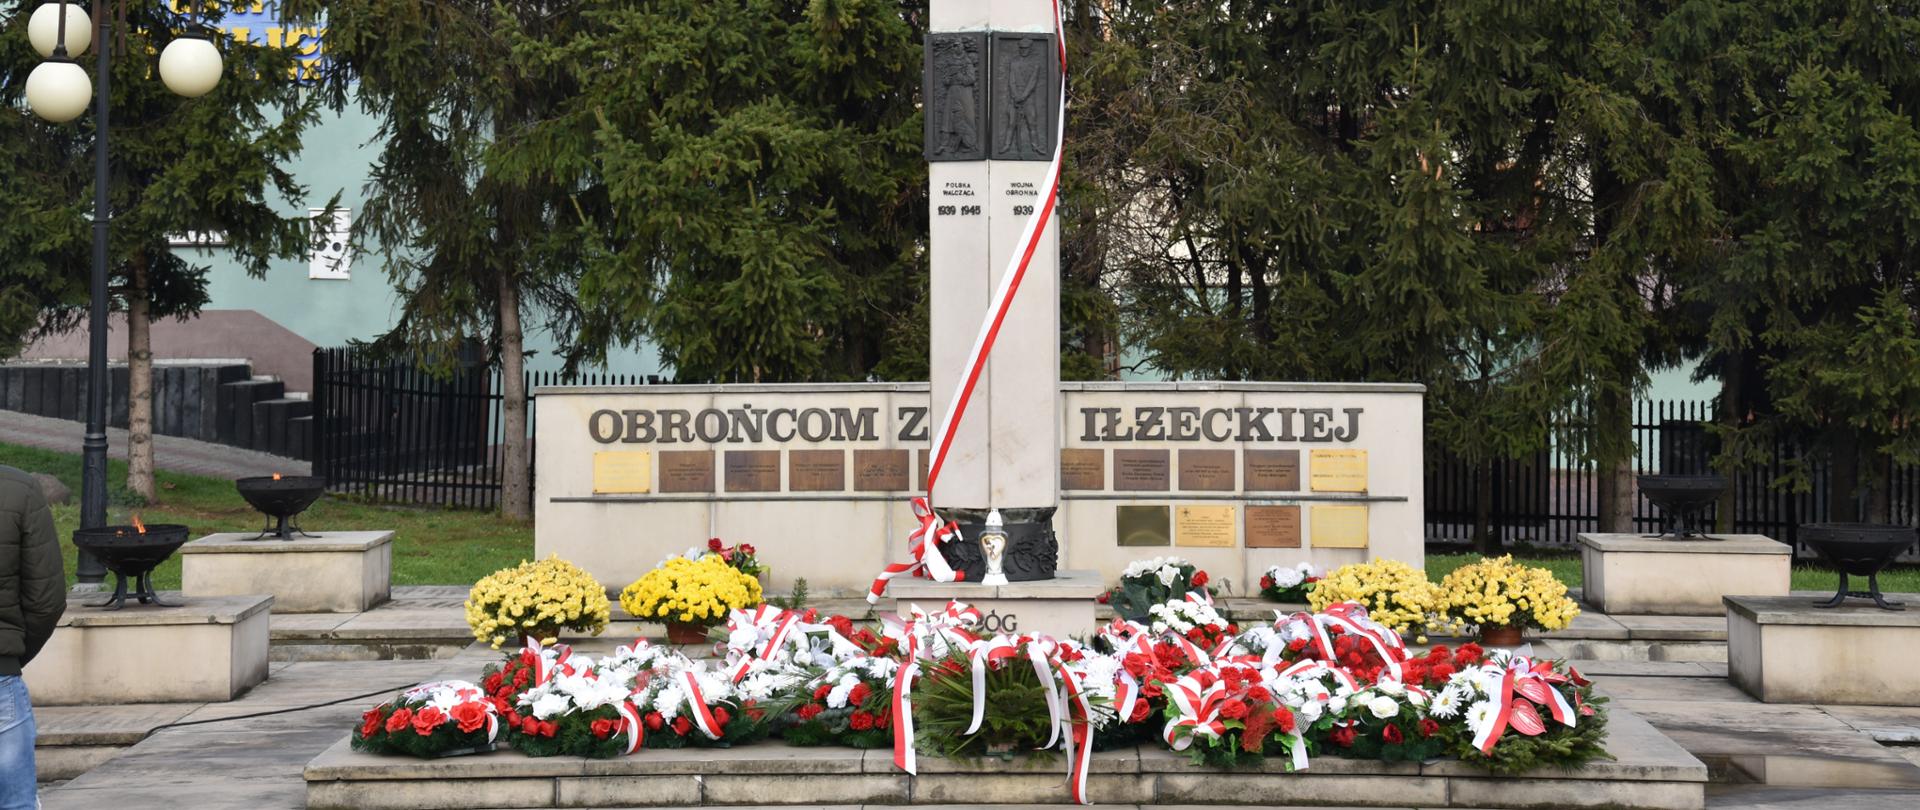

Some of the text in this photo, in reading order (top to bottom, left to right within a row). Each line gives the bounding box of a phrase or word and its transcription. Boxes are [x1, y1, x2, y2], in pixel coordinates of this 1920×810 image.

[938, 205, 981, 215] 1939 1945
[1013, 205, 1034, 215] 1939
[589, 403, 879, 444] OBROŃCOM
[898, 406, 931, 442] Z
